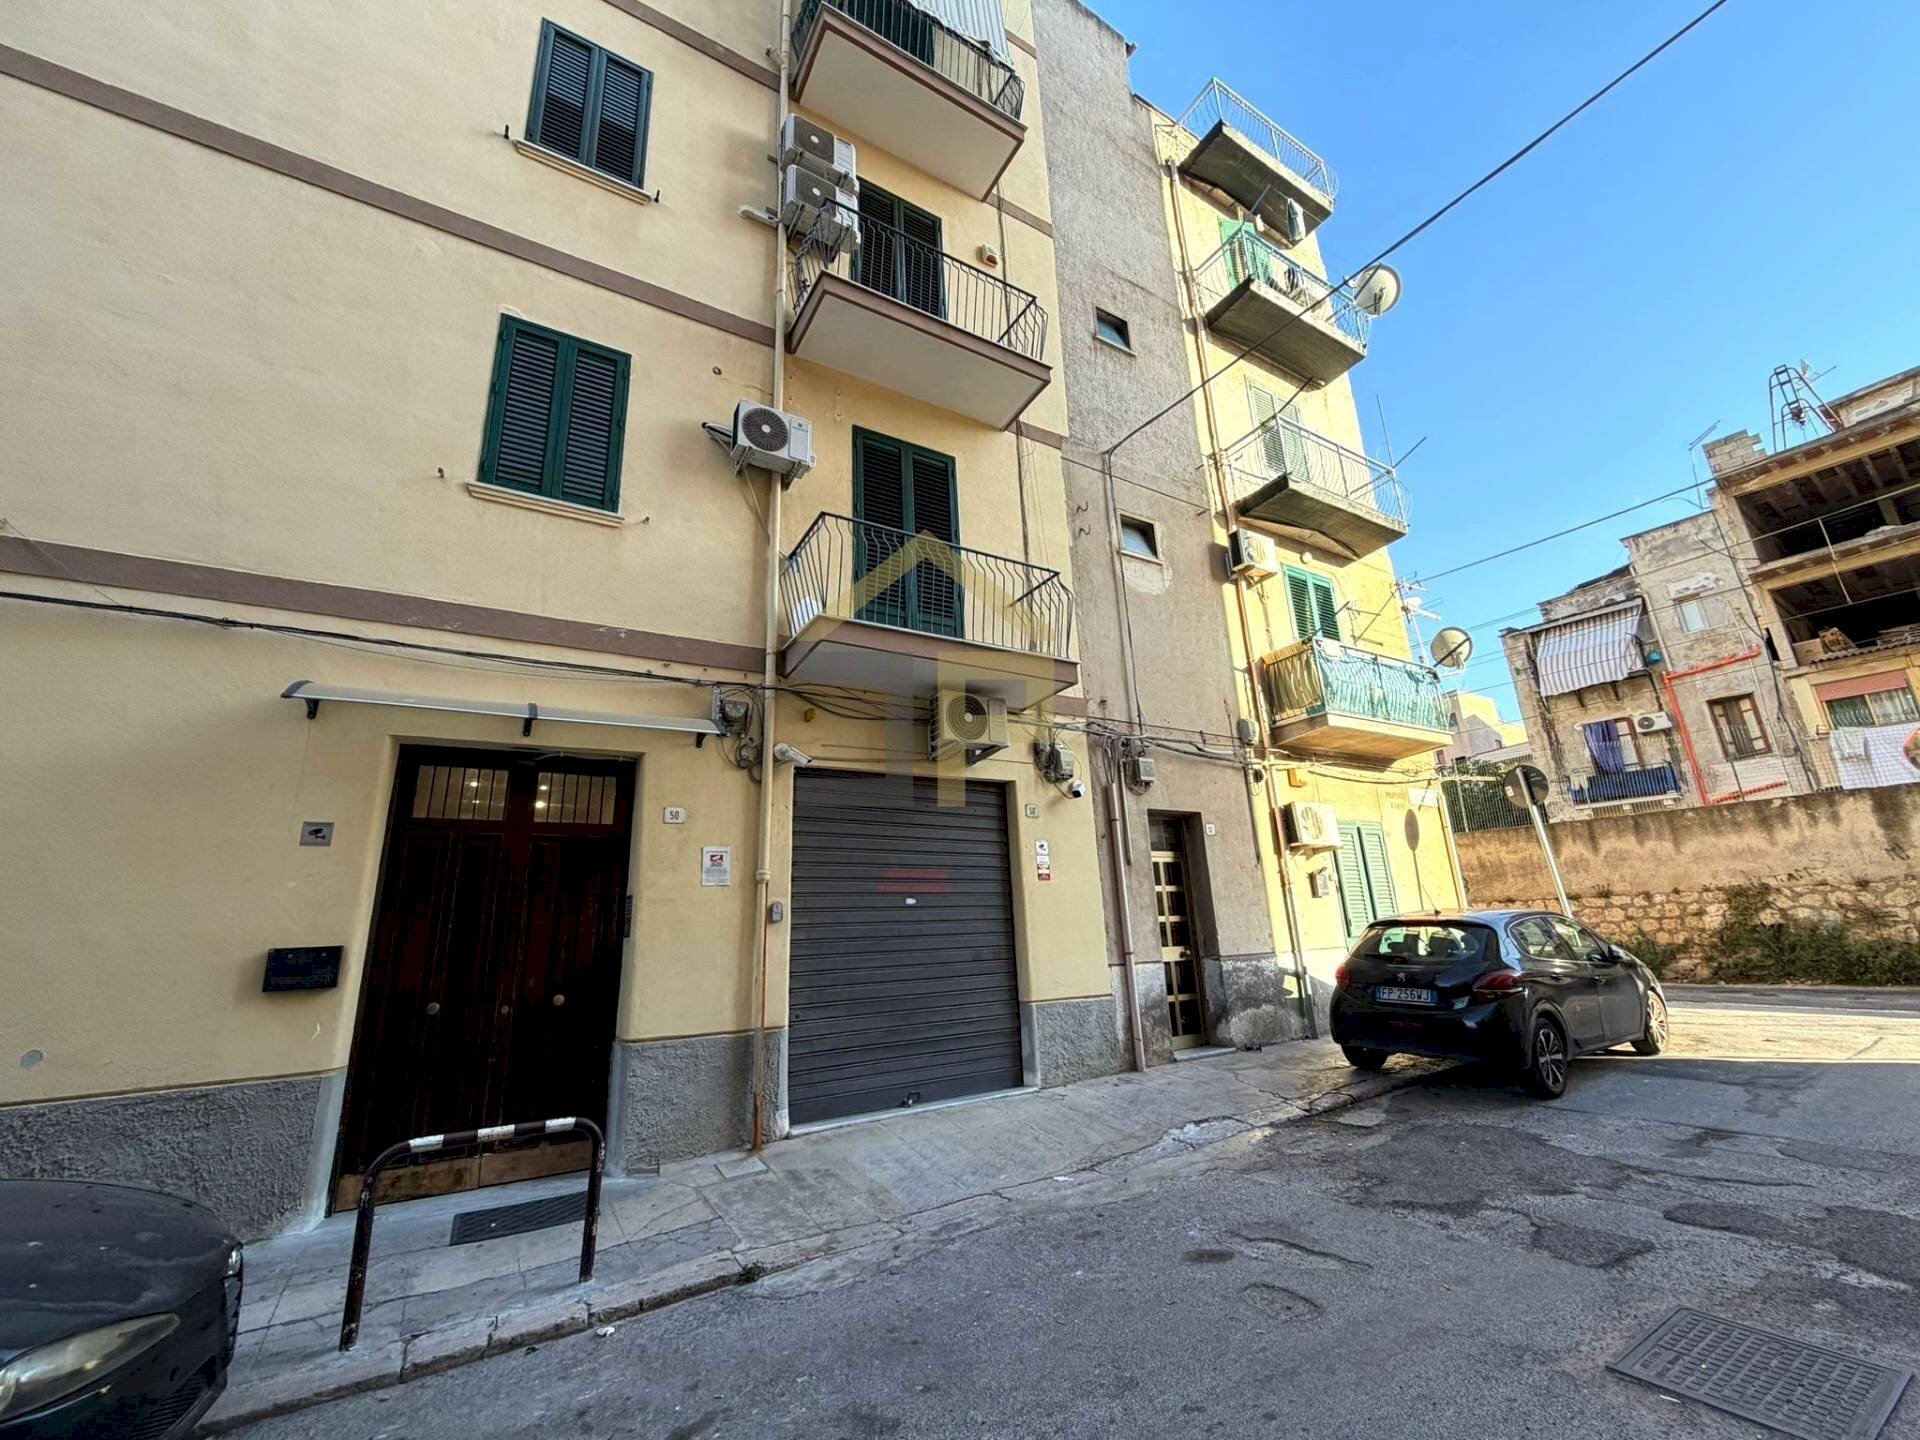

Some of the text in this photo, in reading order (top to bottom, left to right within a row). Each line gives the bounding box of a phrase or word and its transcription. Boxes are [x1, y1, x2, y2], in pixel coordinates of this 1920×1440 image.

[669, 810, 680, 821] 50
[1382, 987, 1430, 1001] FP 256WJ
